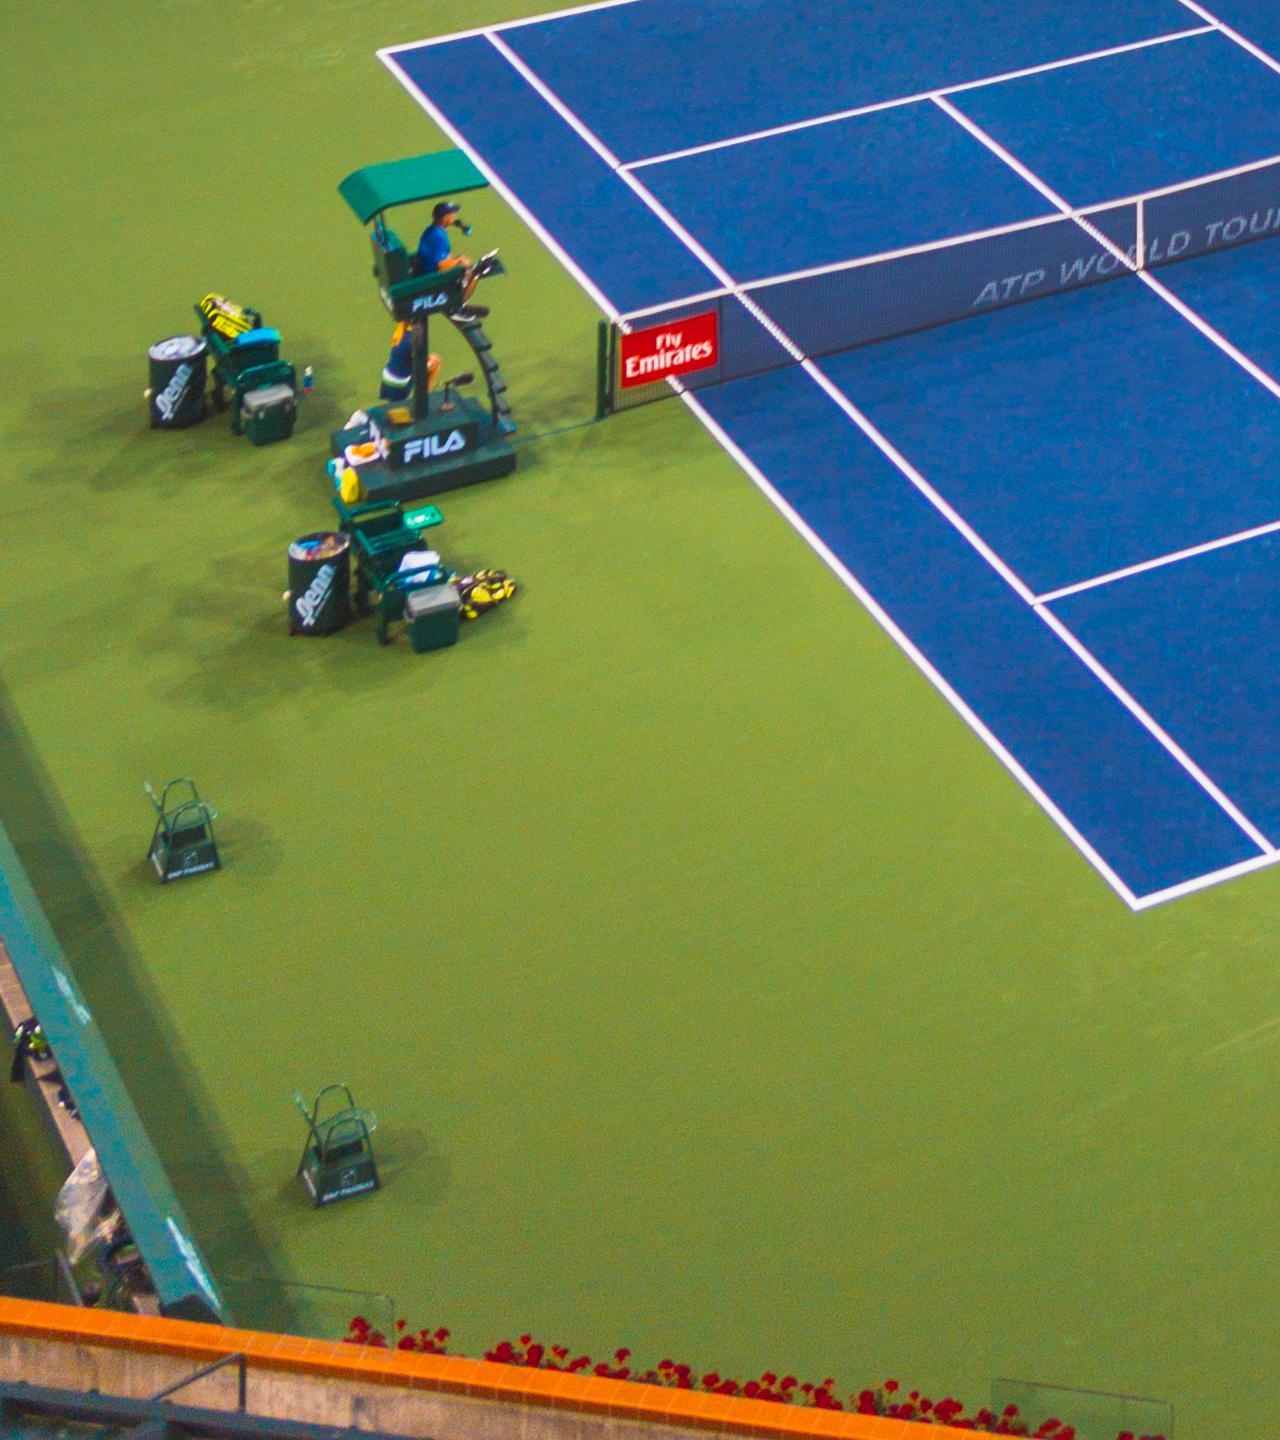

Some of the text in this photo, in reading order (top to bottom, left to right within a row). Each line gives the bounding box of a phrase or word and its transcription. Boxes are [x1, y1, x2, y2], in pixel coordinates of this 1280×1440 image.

[412, 291, 449, 313] FILA
[972, 269, 1045, 306] ATP
[655, 332, 683, 350] Fly
[625, 339, 713, 379] Emirates
[403, 430, 466, 464] FILA
